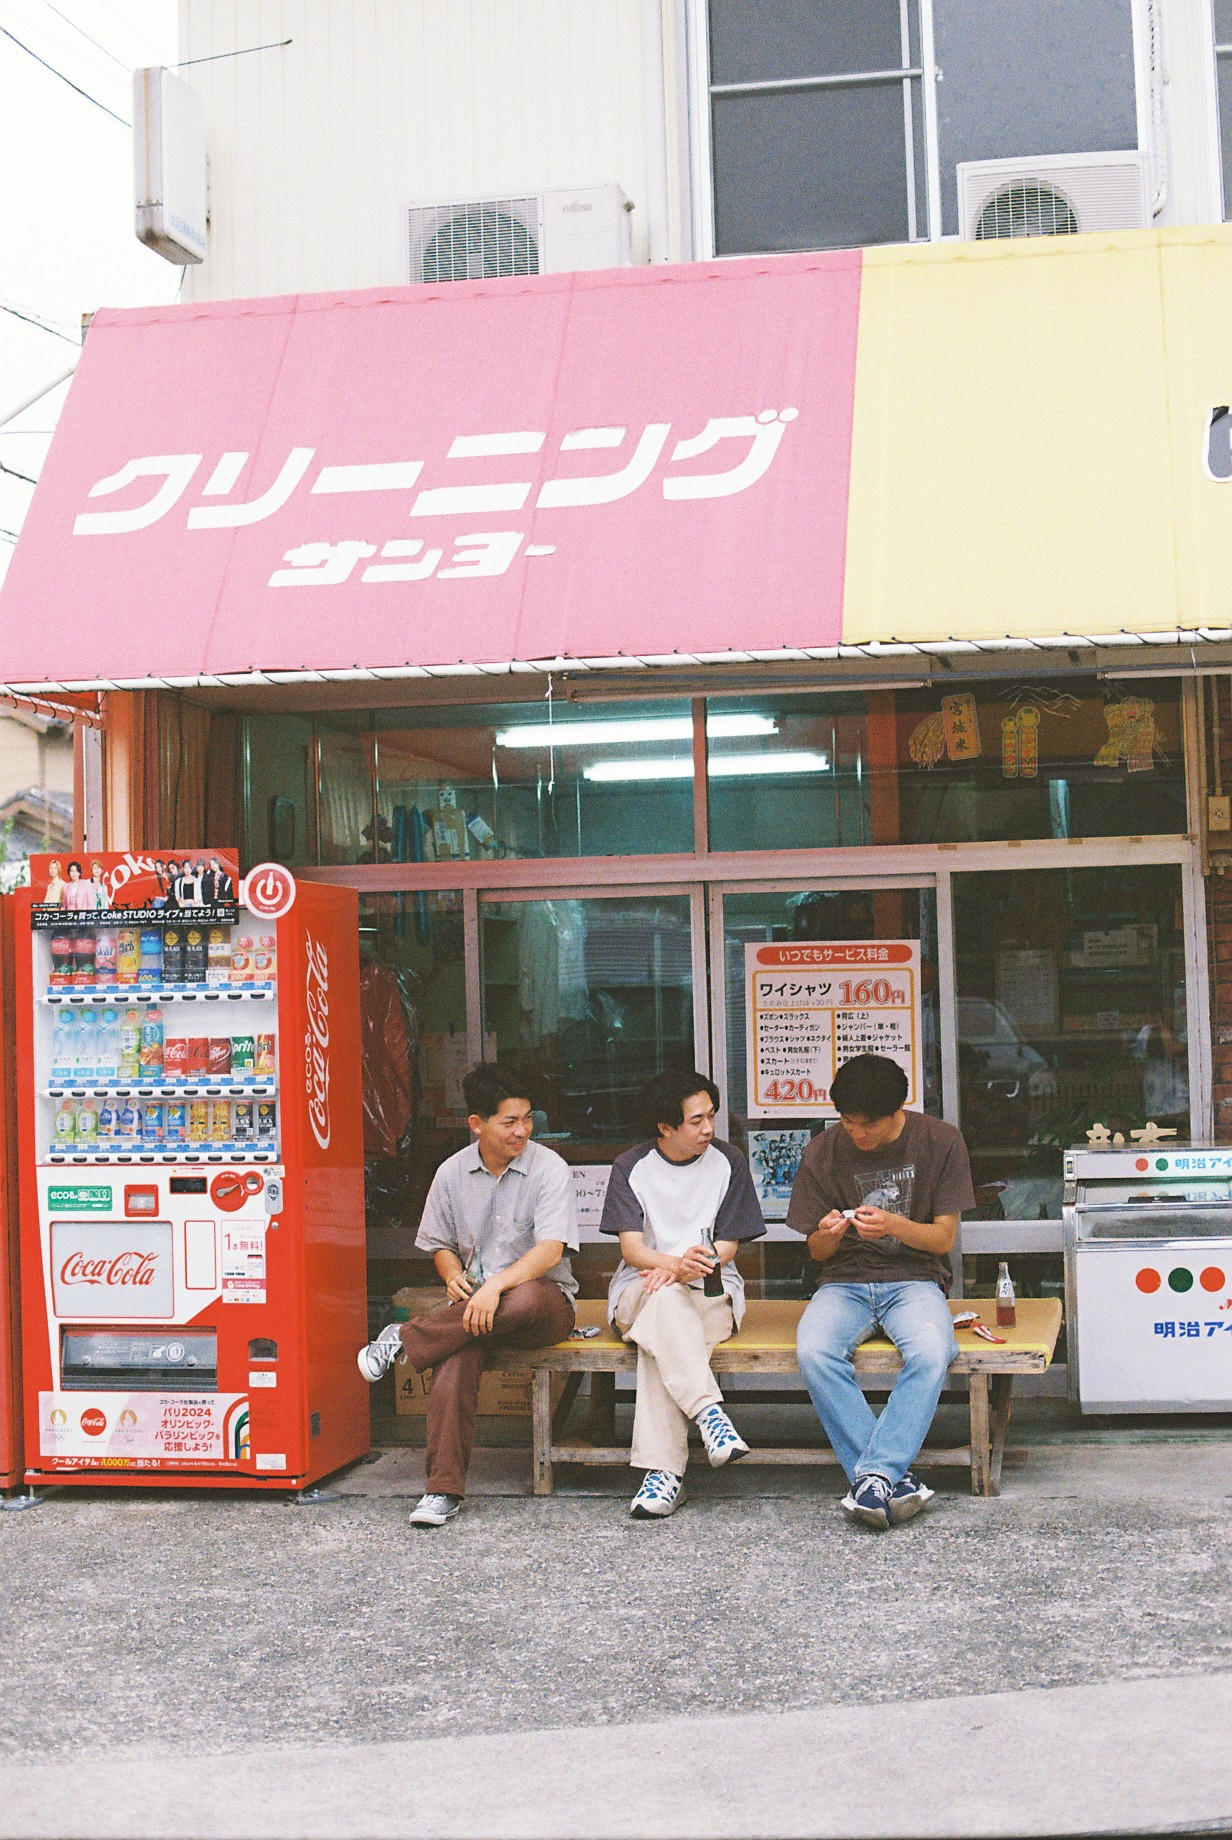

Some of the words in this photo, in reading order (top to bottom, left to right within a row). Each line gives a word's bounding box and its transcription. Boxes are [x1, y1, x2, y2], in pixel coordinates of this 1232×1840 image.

[72, 407, 799, 536] クリーニング
[267, 531, 557, 588] サンヨー
[101, 911, 122, 920] Coke
[123, 911, 156, 919] STUDIO
[779, 948, 889, 962] いつでもサービス料金
[760, 983, 832, 997] ワイシャツ
[839, 978, 905, 1005] 160円
[305, 927, 331, 1149] Coca-Cola
[765, 1057, 790, 1065] スカート
[764, 1078, 827, 1103] 420円
[61, 1252, 159, 1285] Coca-Cola
[402, 1378, 413, 1394] 4
[163, 1408, 212, 1418] パリ2024
[154, 1432, 221, 1441] パラリンピックを
[164, 1443, 212, 1452] 応援しよう!
